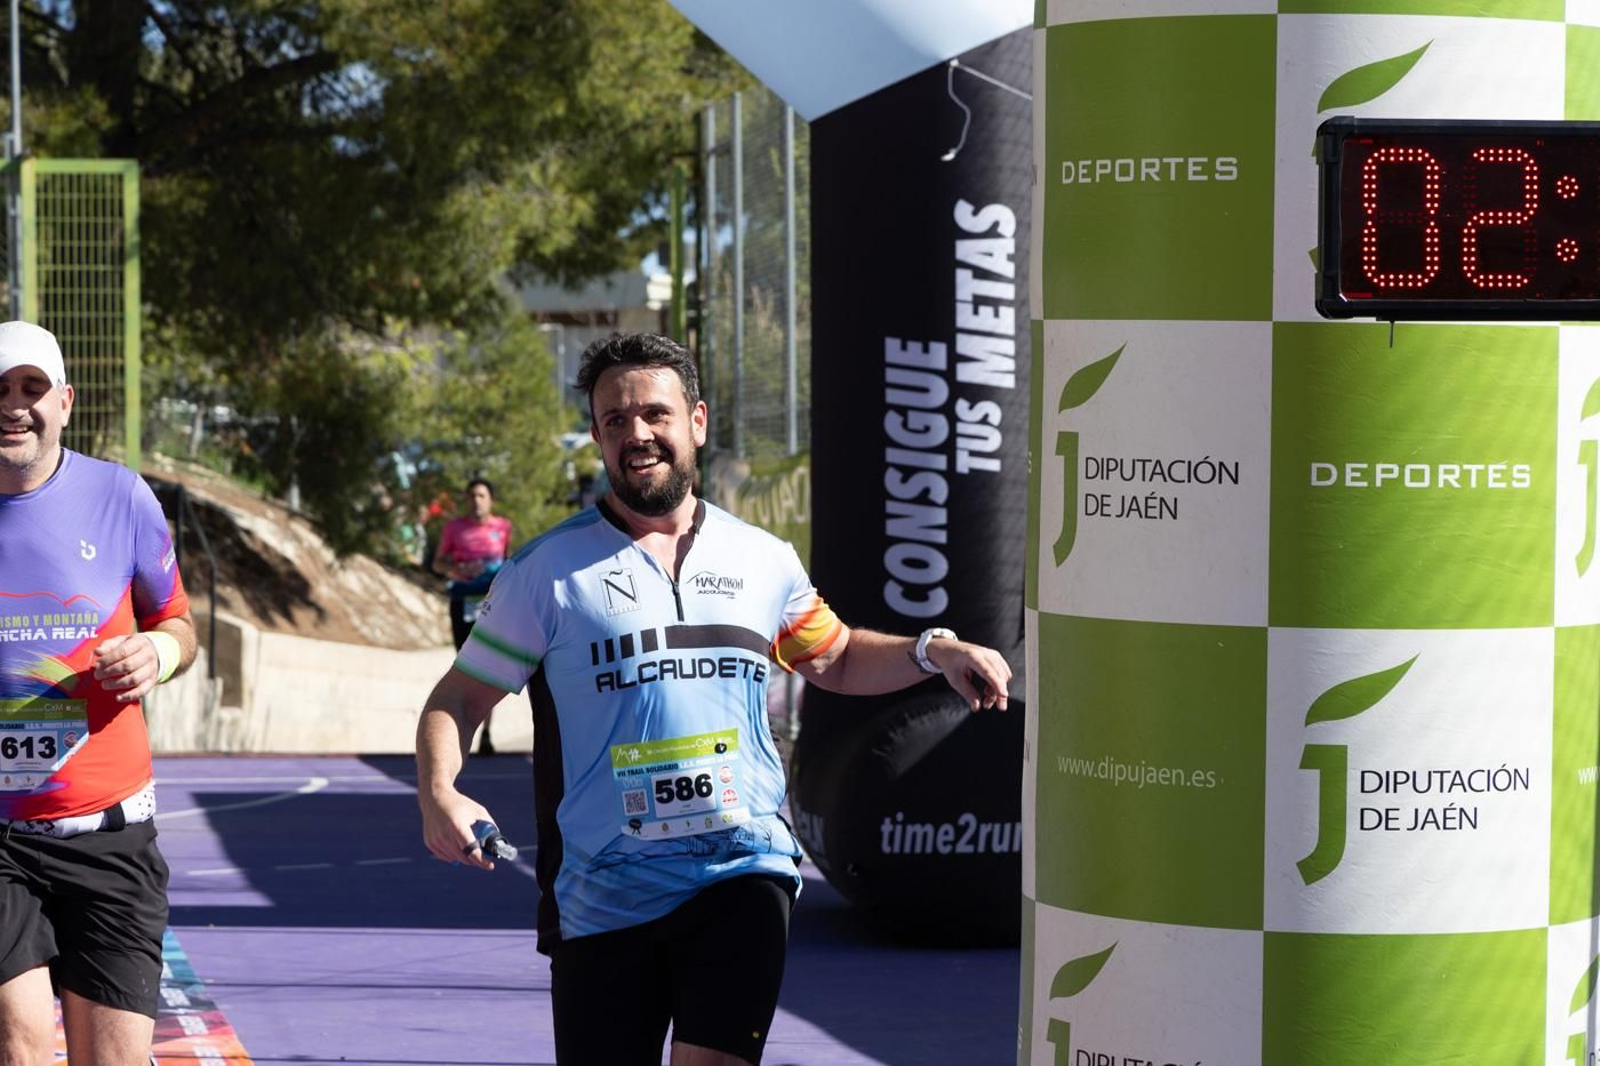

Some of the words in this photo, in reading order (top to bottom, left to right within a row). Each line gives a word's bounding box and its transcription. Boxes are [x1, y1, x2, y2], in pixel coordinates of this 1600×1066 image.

[1061, 156, 1239, 184] DEPORTES
[953, 198, 1016, 389] METAS
[955, 397, 1002, 475] TUS
[883, 336, 949, 619] CONSIGUE
[1084, 455, 1240, 486] DIPUTACIÓN
[1310, 461, 1532, 489] DEPORTES
[1084, 494, 1112, 517] DE
[1115, 490, 1179, 521] JAÉN
[43, 611, 99, 627] MONTAÑA
[52, 626, 99, 641] REAL
[595, 657, 767, 693] ALCAUDETE
[1, 736, 57, 759] 613
[1057, 754, 1216, 789] www.dipujaen.es
[1359, 764, 1530, 795] DIPUTACIÓN
[655, 773, 713, 804] 586
[1359, 807, 1400, 832] DE
[1406, 802, 1479, 832] JAÉN
